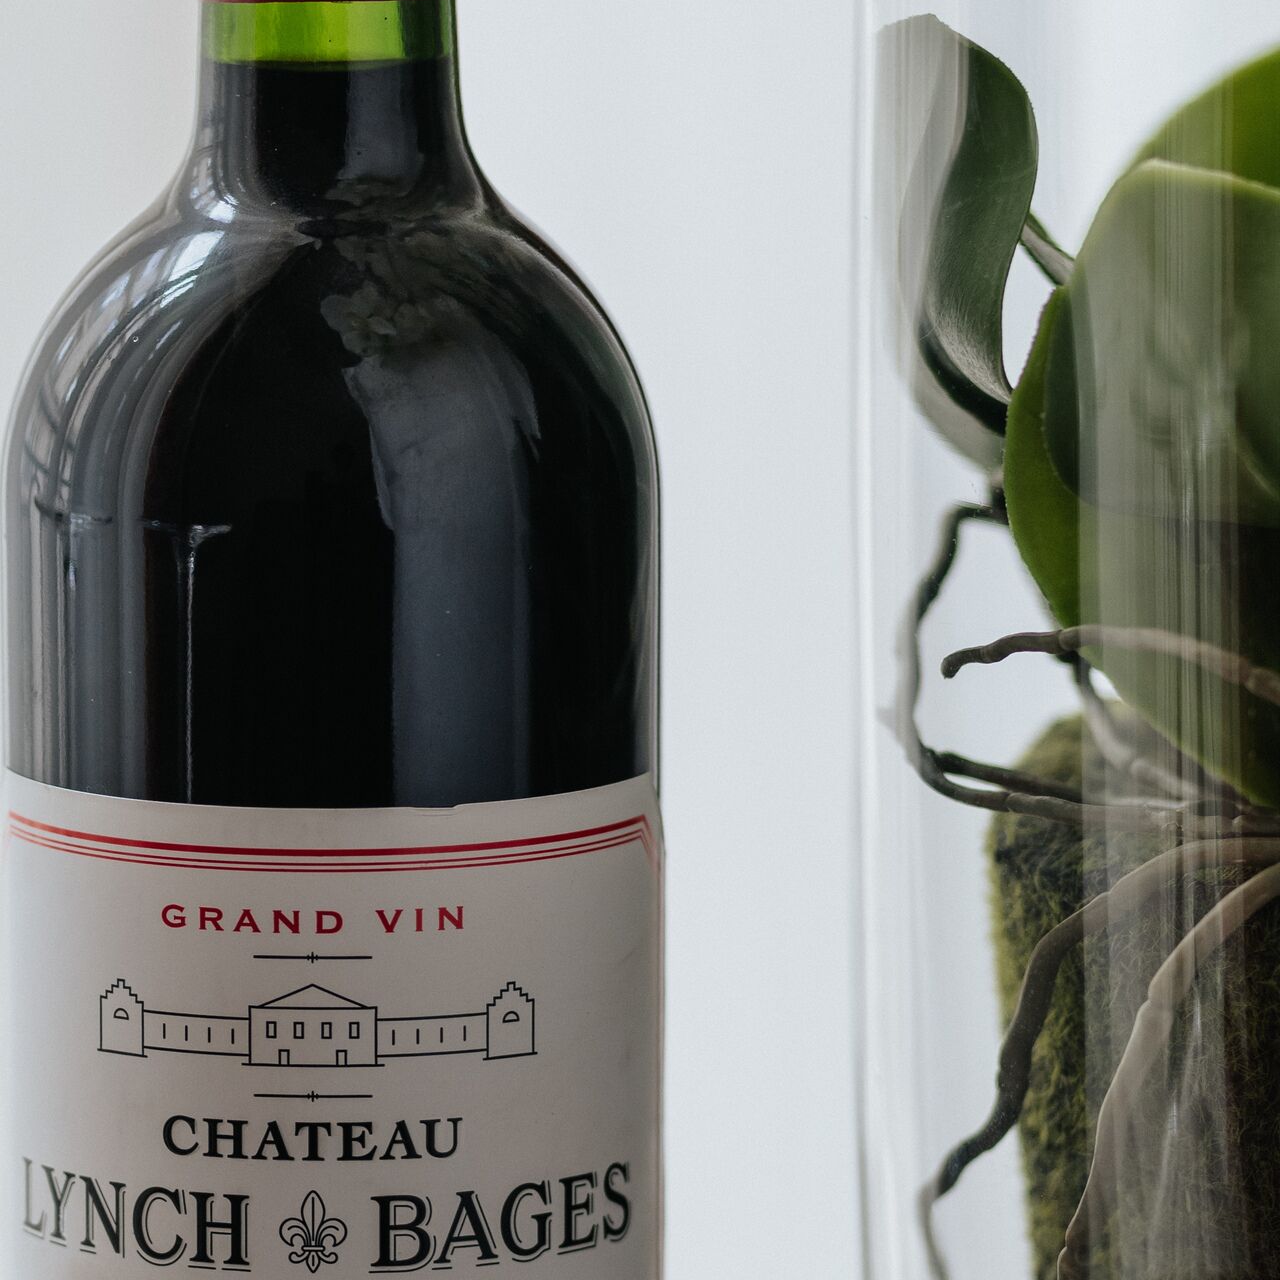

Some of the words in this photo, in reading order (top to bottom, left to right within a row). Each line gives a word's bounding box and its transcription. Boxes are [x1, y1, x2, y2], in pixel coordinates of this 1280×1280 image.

[161, 903, 345, 935] GRAND
[375, 904, 466, 934] VIN
[162, 1114, 464, 1162] CHATEAU
[22, 1156, 252, 1273] LYNCH
[368, 1160, 632, 1273] BAGES
